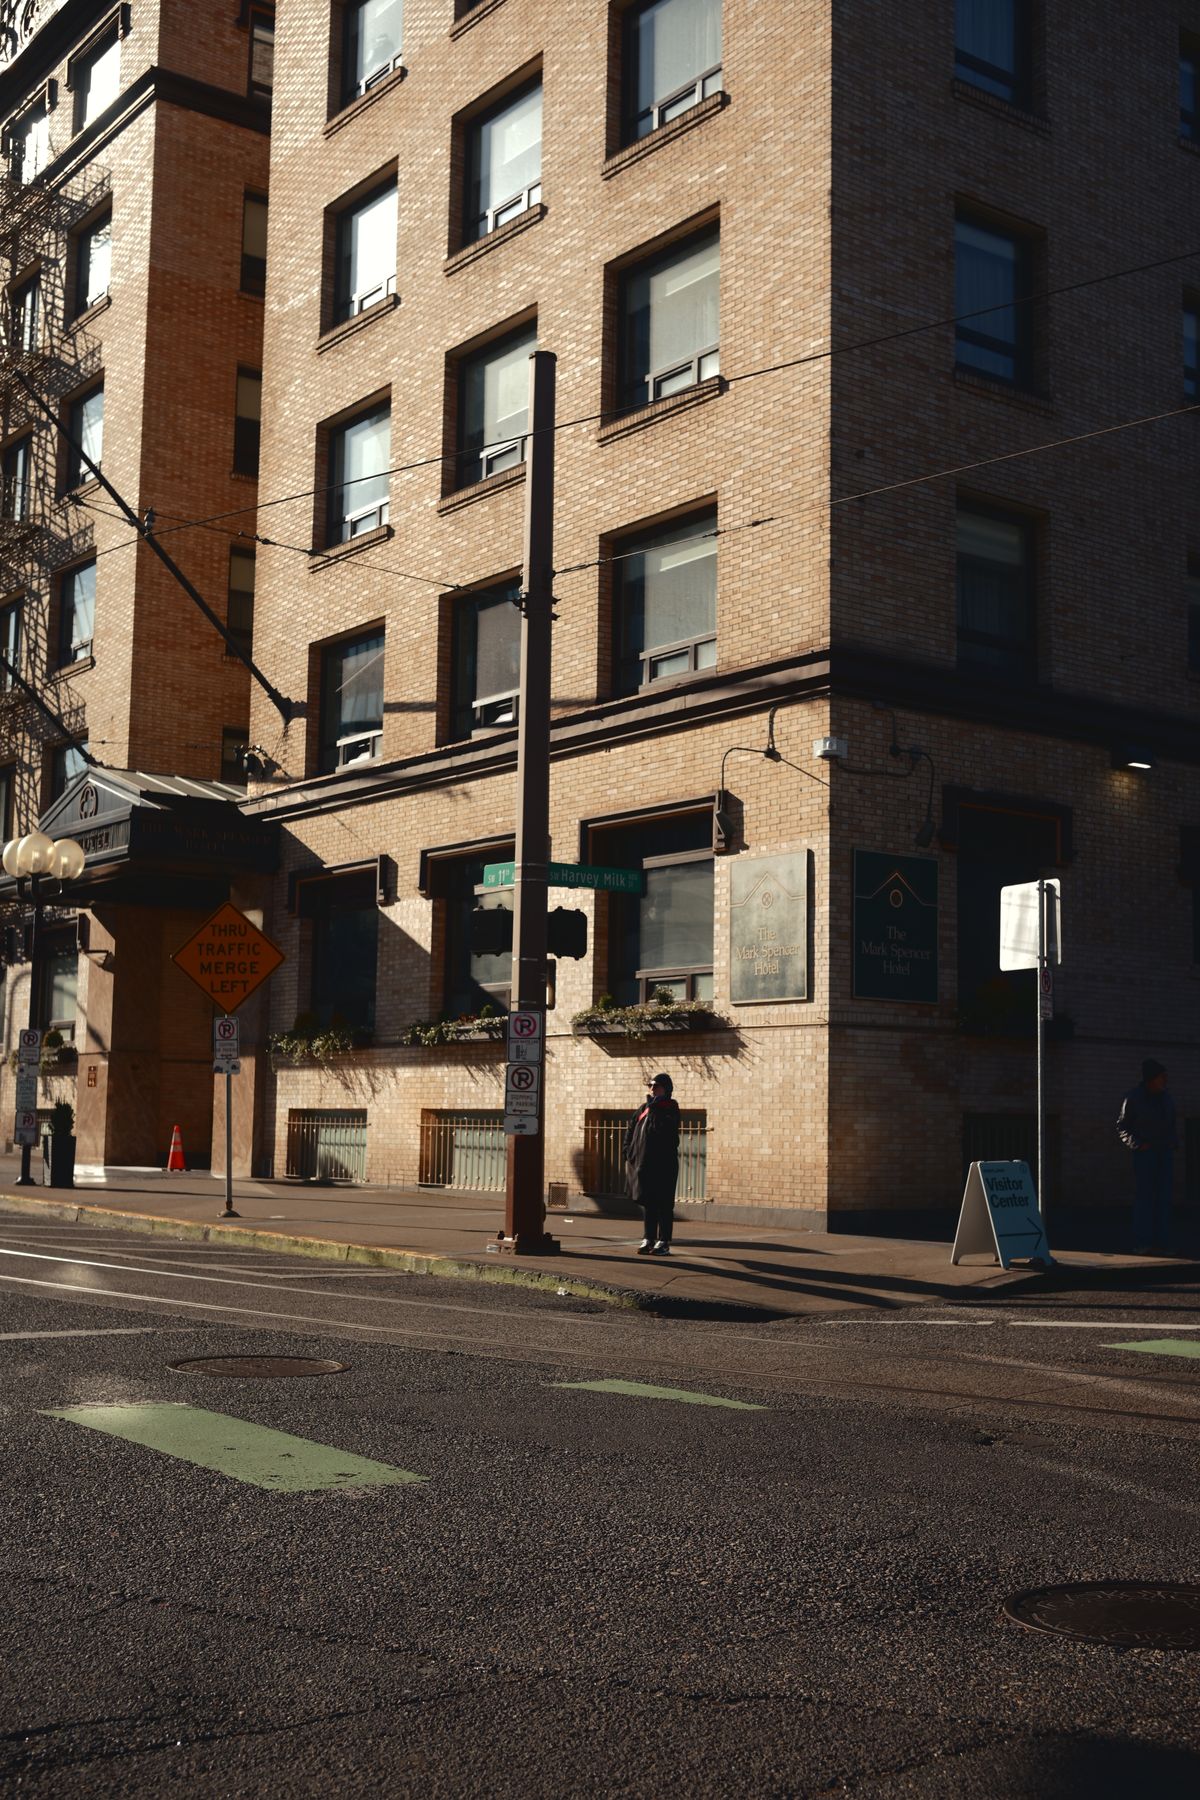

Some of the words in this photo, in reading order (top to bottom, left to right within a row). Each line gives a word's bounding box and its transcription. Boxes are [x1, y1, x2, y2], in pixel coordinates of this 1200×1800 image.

[550, 872, 559, 880] SW
[561, 869, 599, 887] Harvey
[604, 873, 626, 887] Milk
[211, 924, 248, 936] THRU
[757, 928, 777, 940] The
[886, 925, 906, 940] The
[197, 943, 261, 956] TRAFFIC
[736, 948, 759, 961] Mark
[761, 945, 801, 961] Spencer
[861, 940, 888, 956] Mark
[890, 943, 932, 961] Spencer
[200, 962, 259, 975] MERGE
[755, 961, 779, 976] Hotel
[882, 959, 911, 976] Hotel
[211, 980, 249, 993] LEFT
[985, 1177, 1023, 1191] Visitor
[990, 1194, 1029, 1208] Center
